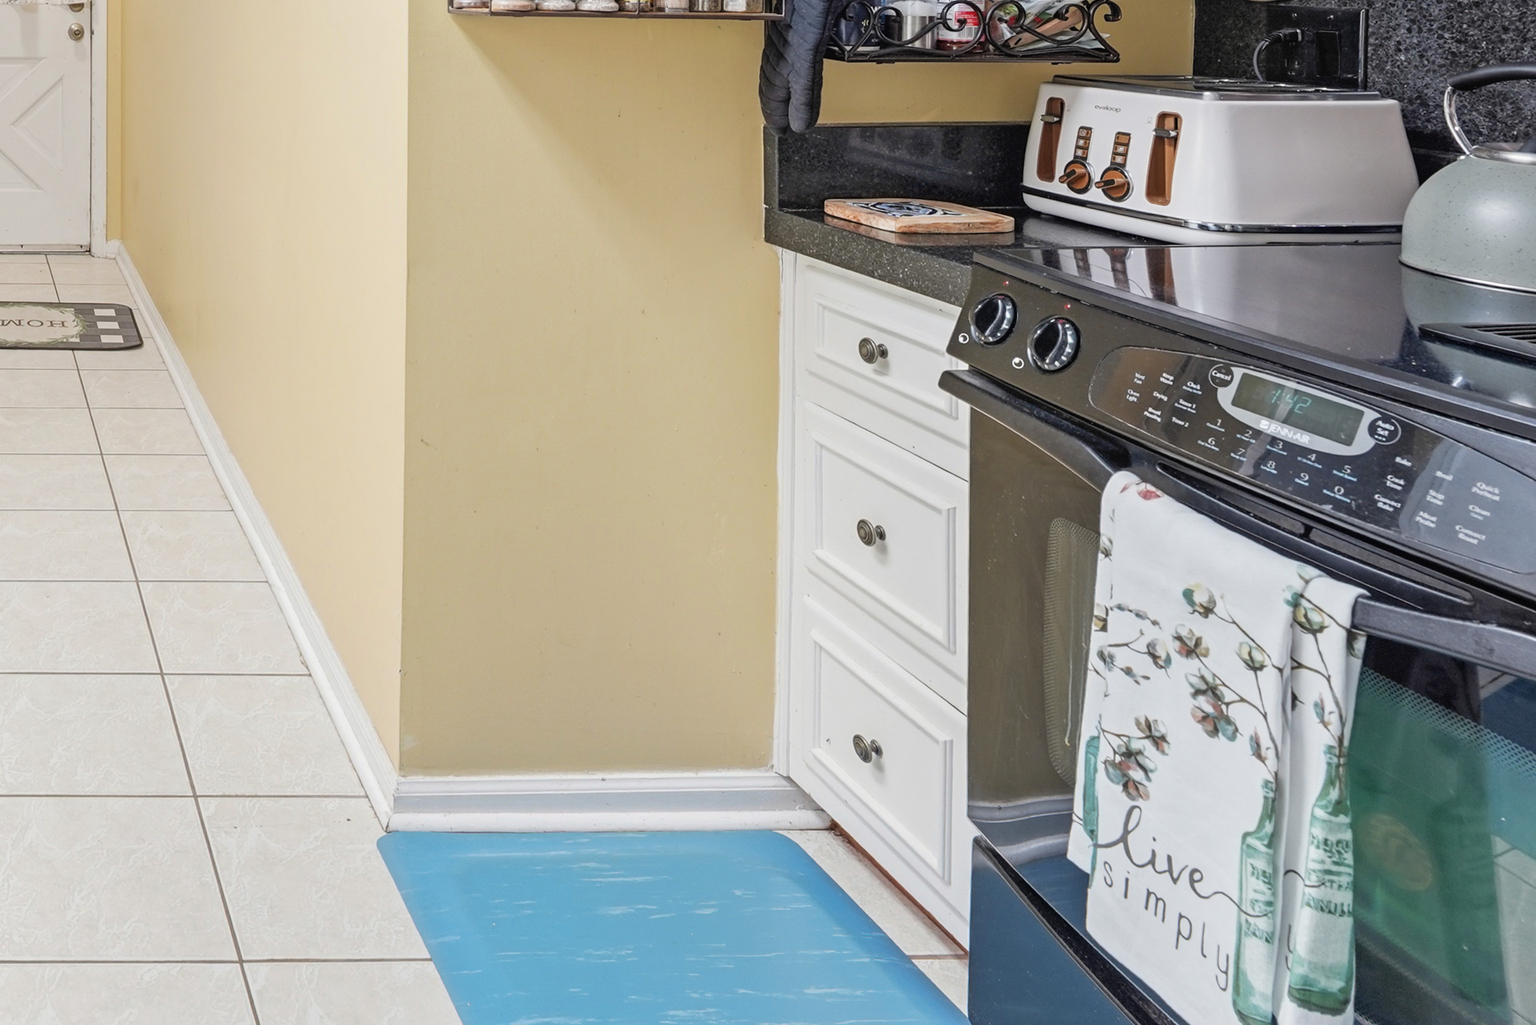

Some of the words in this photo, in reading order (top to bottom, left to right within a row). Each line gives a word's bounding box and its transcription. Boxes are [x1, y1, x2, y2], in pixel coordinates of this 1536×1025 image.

[1211, 370, 1232, 381] Cancel
[1153, 391, 1168, 402] Drying
[1271, 389, 1312, 415] 1:42
[1375, 420, 1395, 431] Auto
[1244, 429, 1252, 437] 2
[1266, 422, 1310, 444] JENN-AIR
[1376, 428, 1389, 437] Set
[1208, 437, 1216, 445] 6
[1275, 440, 1283, 449] 3
[1308, 453, 1317, 461] 4
[1267, 460, 1276, 469] 8
[1342, 465, 1352, 474] 5
[1300, 472, 1309, 481] 9
[1334, 486, 1344, 495] 0
[1468, 504, 1491, 516] Clean
[1089, 804, 1234, 902] live
[1102, 860, 1230, 992] simply
